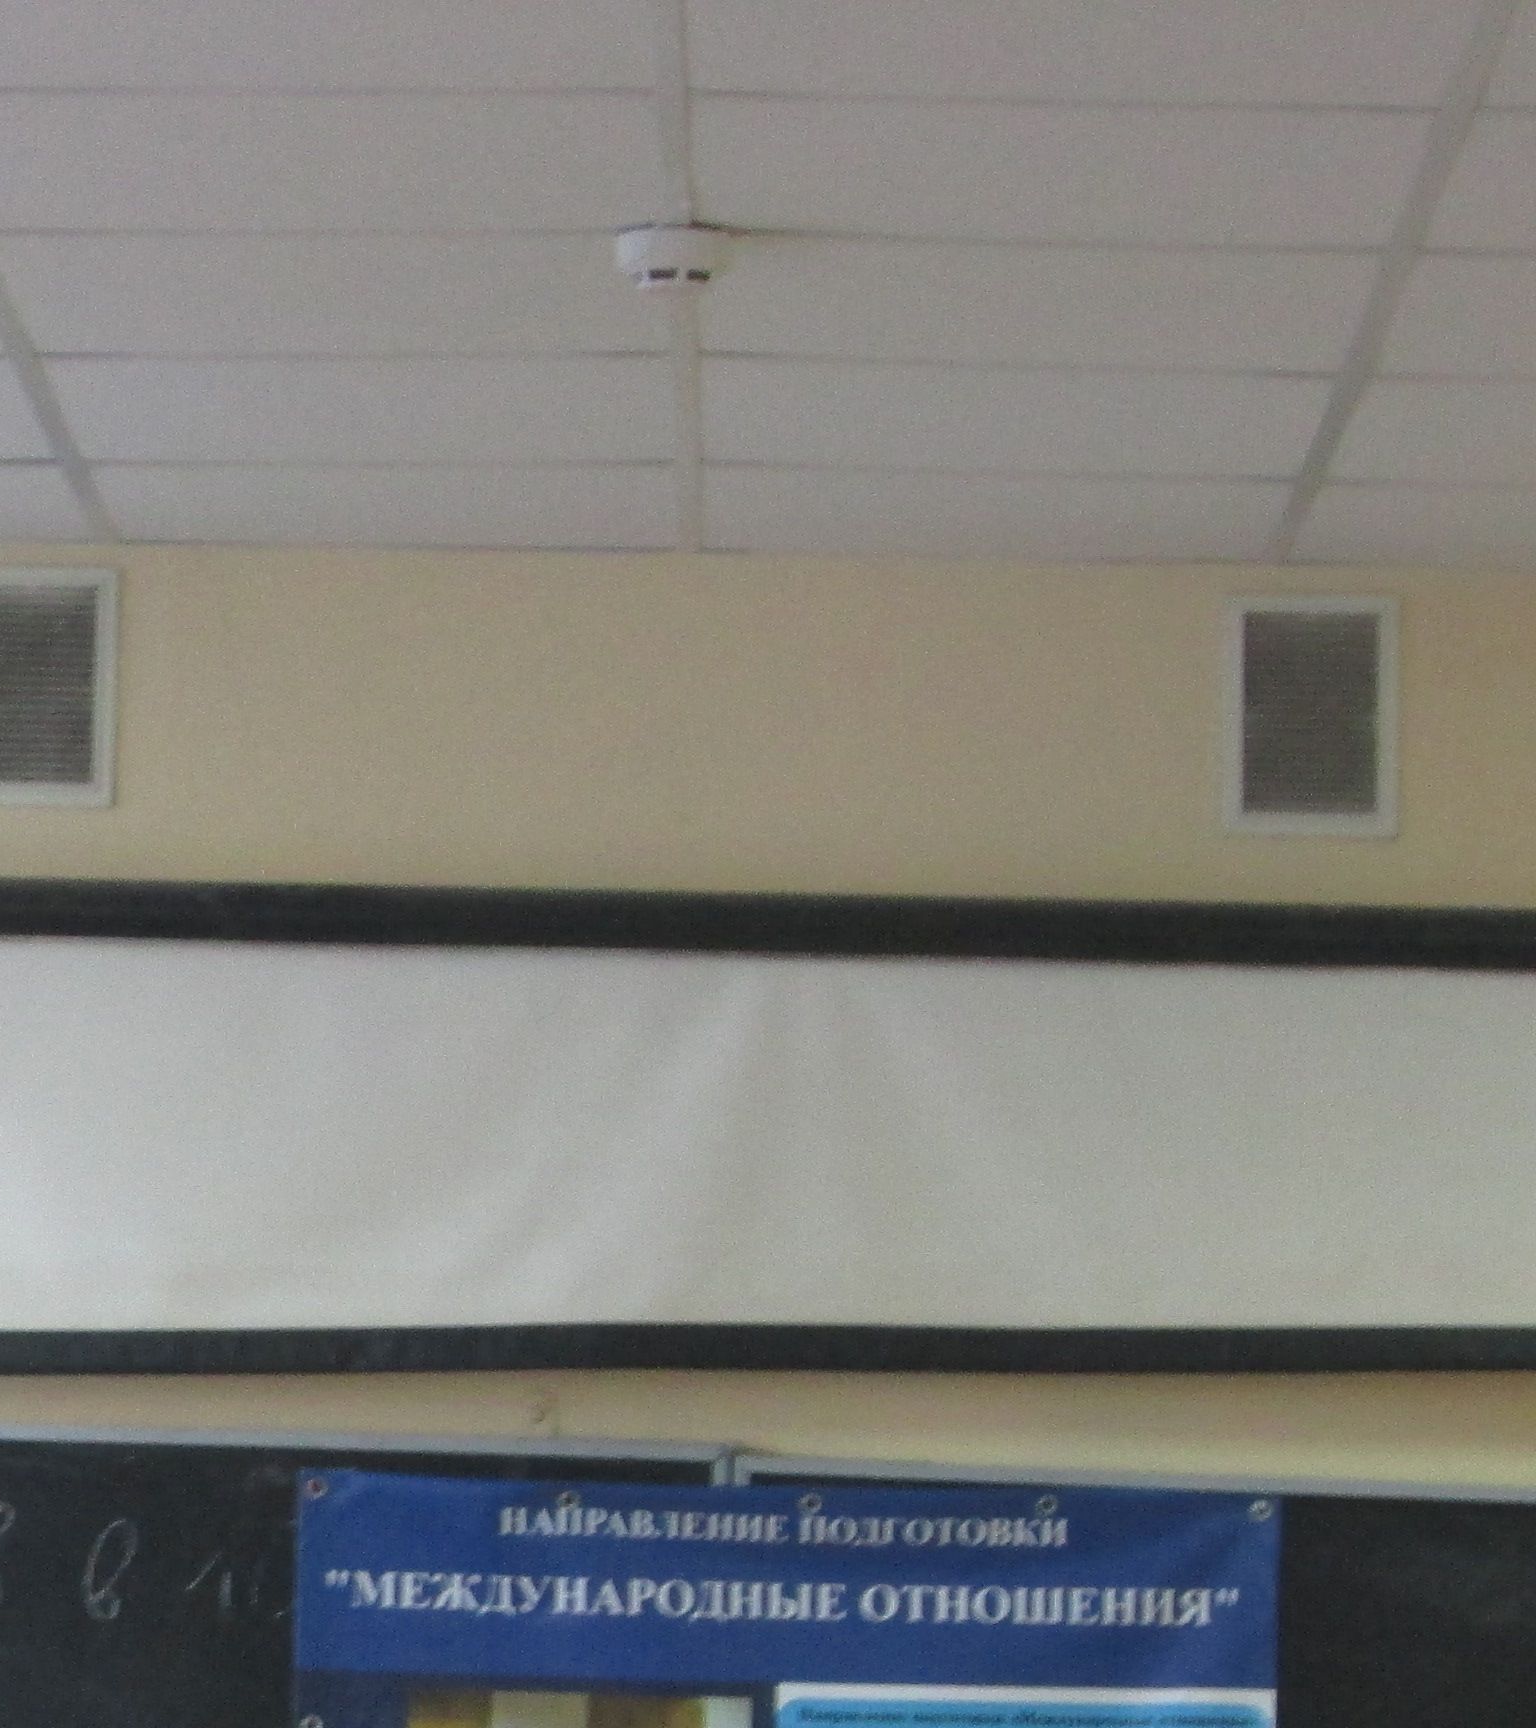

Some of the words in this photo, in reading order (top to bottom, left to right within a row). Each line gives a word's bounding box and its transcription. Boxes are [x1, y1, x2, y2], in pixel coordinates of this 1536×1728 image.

[498, 1504, 789, 1544] НАПРАВЛЕНИЕ
[797, 1511, 1070, 1549] ПОДГОТОВКИ
[325, 1568, 847, 1624] "МЕЖДУНАРОДНЫЕ
